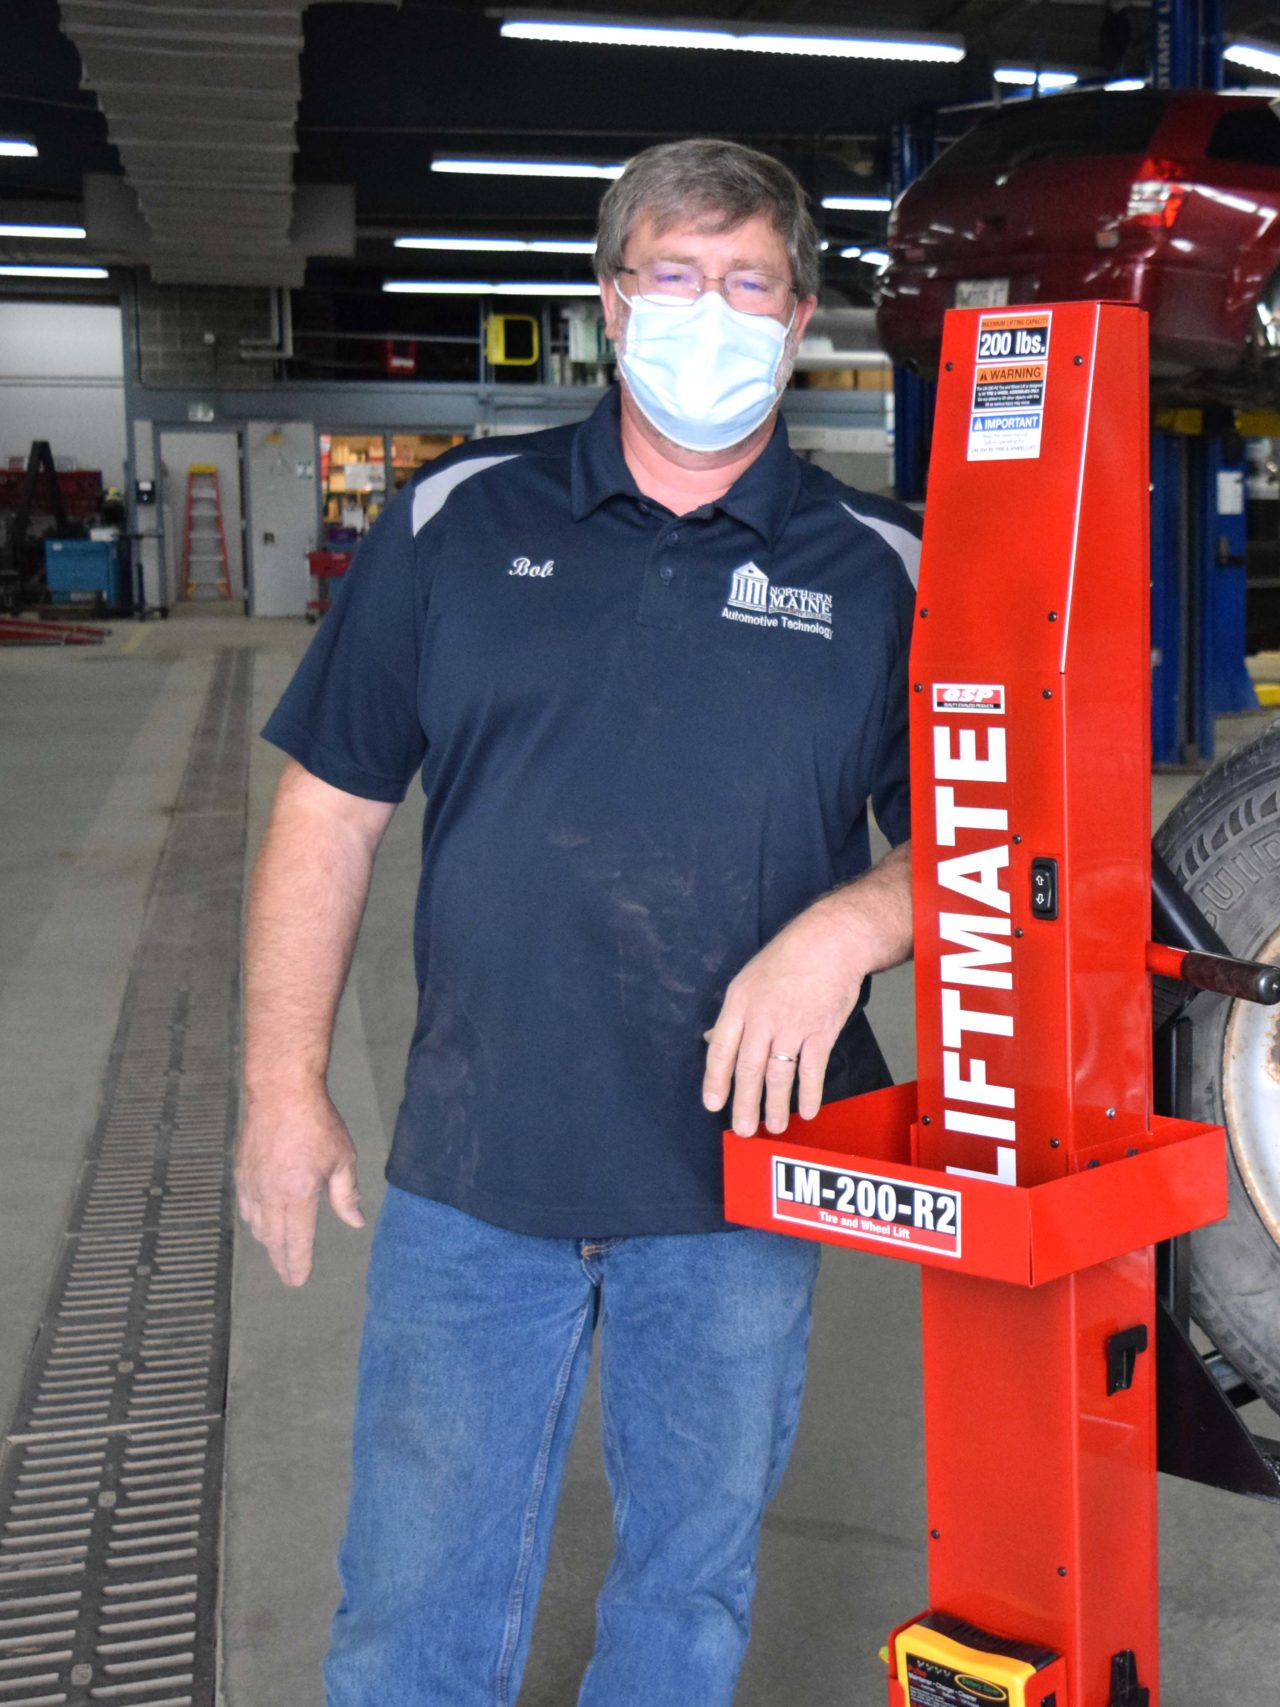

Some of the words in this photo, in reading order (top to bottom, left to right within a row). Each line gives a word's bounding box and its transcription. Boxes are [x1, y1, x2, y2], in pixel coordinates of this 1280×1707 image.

[980, 331, 1012, 356] 200
[1015, 329, 1046, 354] lbs.
[990, 367, 1041, 380] WARNING
[984, 416, 1039, 430] IMPORTANT
[509, 557, 555, 578] Bob
[769, 586, 833, 604] NORTHERN
[769, 594, 833, 617] MAINE
[721, 607, 779, 627] Automotive
[781, 616, 834, 640] Technology
[933, 725, 1018, 1187] LIFTMATE
[777, 1162, 956, 1235] LM-200-R2
[819, 1210, 838, 1224] Tire
[840, 1217, 858, 1228] and
[861, 1219, 890, 1235] Wheel
[893, 1226, 910, 1239] Lift
